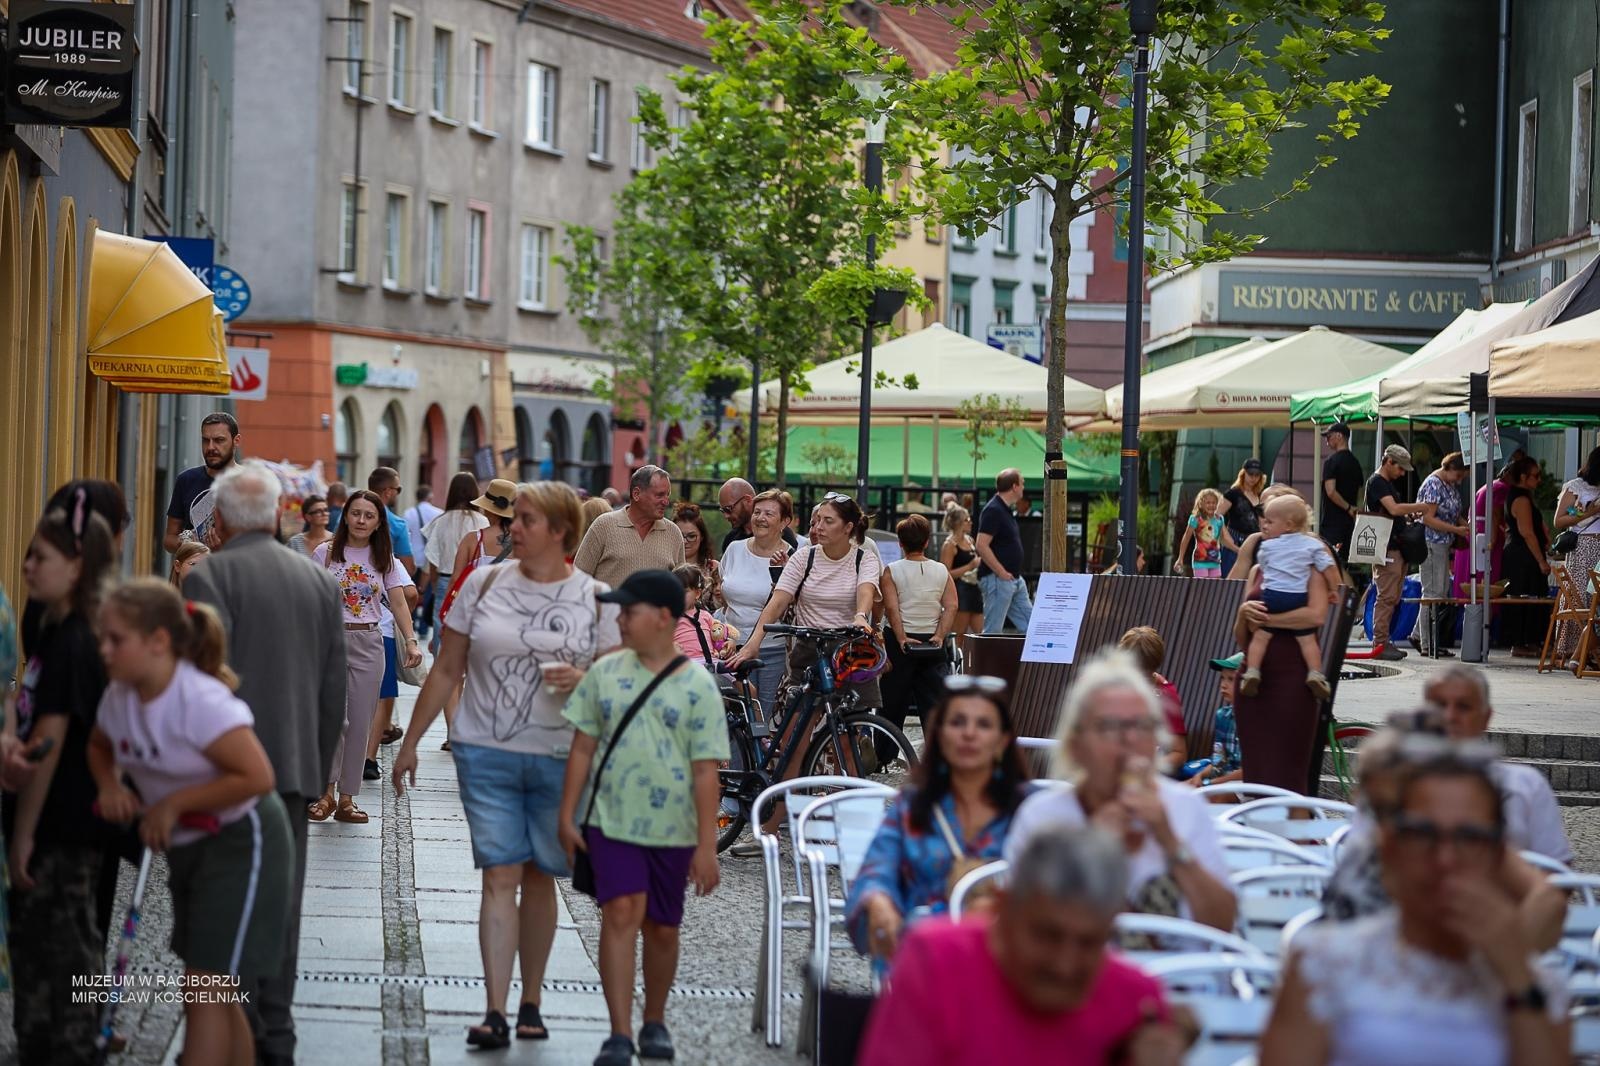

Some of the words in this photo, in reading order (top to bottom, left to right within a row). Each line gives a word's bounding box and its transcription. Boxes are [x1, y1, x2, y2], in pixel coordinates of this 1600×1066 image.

[19, 27, 122, 50] JUBILER
[54, 53, 86, 64] 1989
[17, 79, 49, 96] M.
[54, 80, 120, 104] Karpisz
[1232, 285, 1378, 312] RISTORANTE
[1385, 291, 1400, 312] &
[1408, 291, 1467, 313] CAFE
[92, 361, 154, 374] PIEKARNIA
[156, 364, 202, 376] CUKIERNIA
